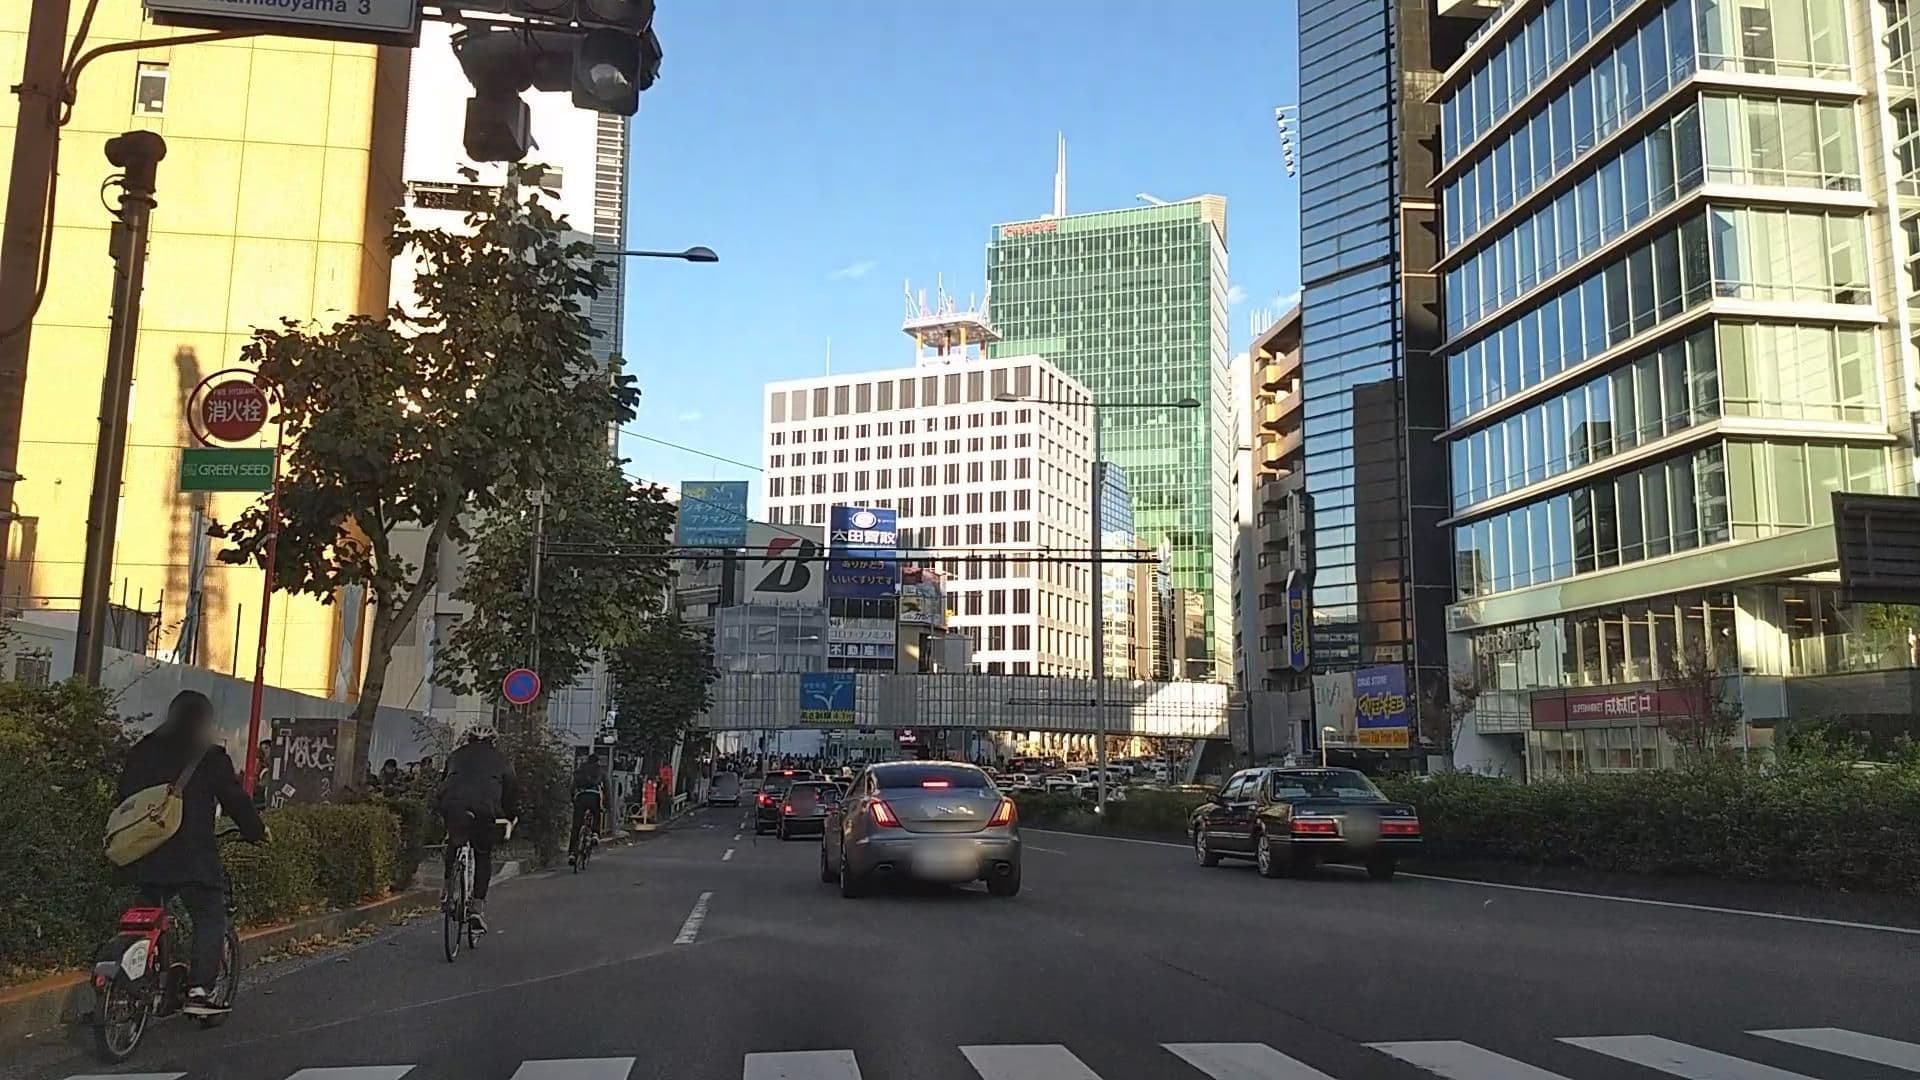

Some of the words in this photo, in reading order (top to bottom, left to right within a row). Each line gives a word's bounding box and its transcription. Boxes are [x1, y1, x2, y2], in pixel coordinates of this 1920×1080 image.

[357, 0, 370, 14] 3
[207, 398, 262, 423] 消火栓
[198, 464, 239, 476] GREEN
[240, 464, 271, 476] SEED
[831, 644, 875, 656] 不動産
